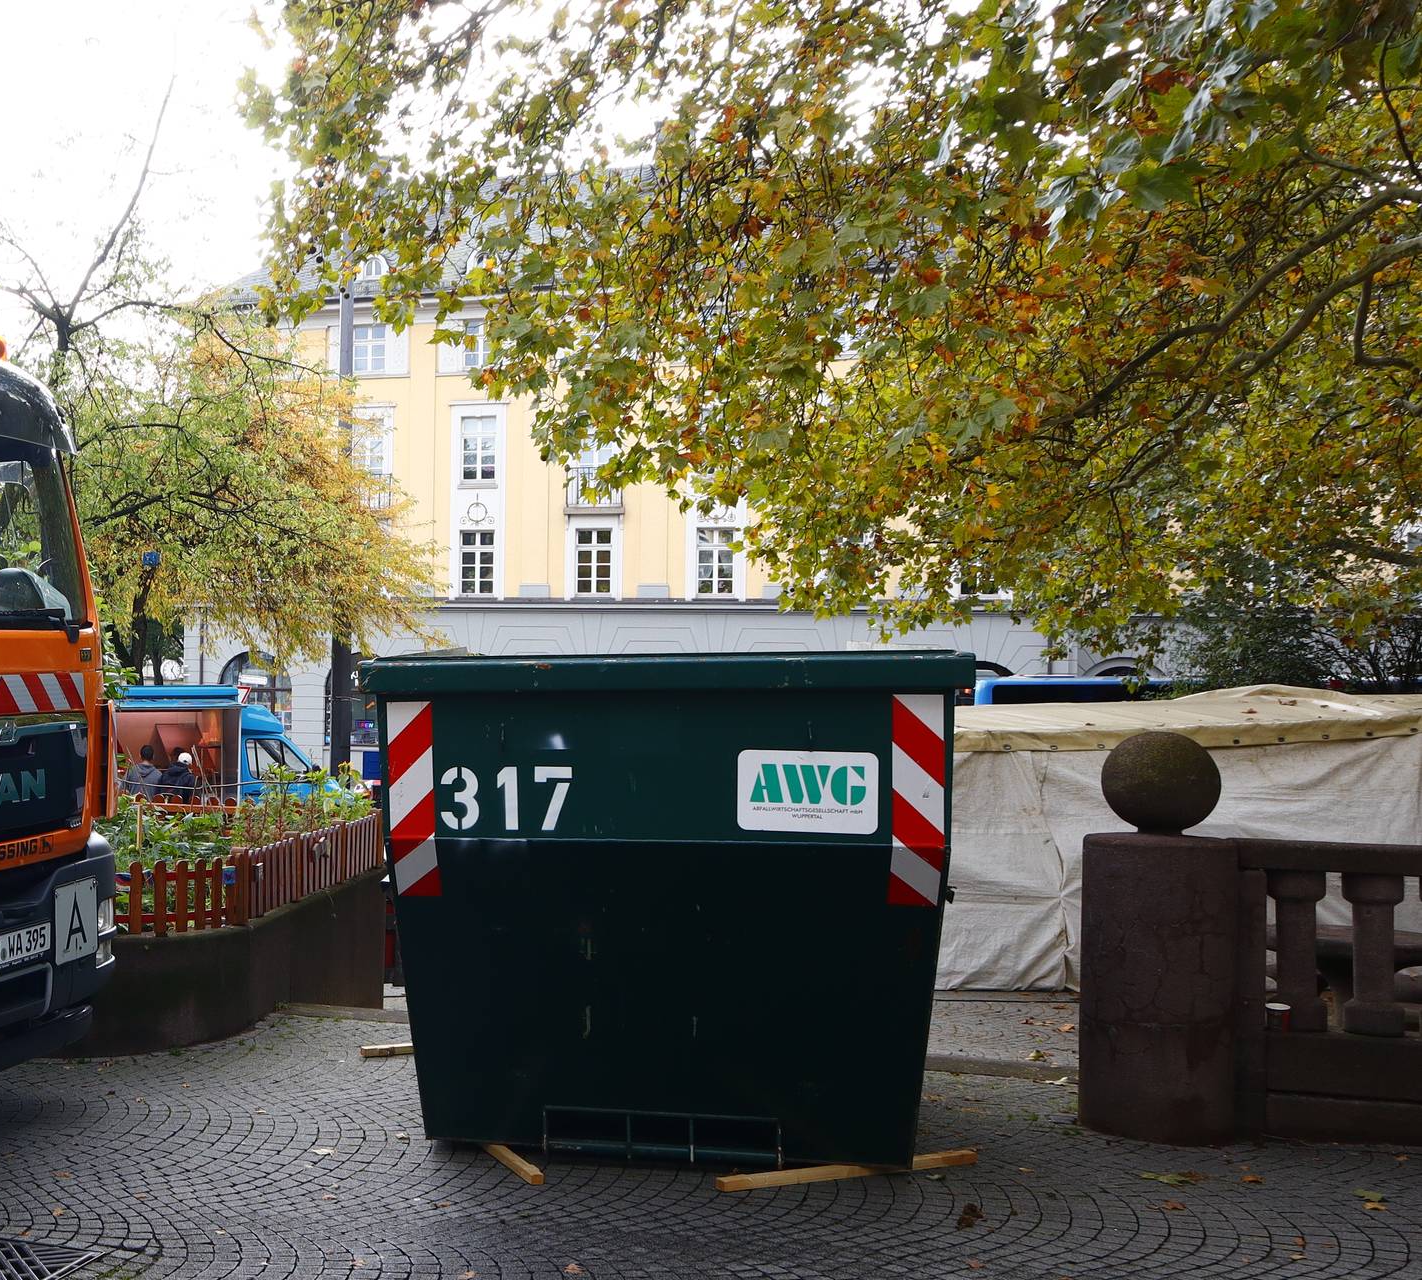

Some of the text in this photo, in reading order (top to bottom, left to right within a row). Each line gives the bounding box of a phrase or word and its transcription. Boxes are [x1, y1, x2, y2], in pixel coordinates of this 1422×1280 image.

[440, 766, 573, 831] 317
[749, 763, 867, 806] AWG
[752, 806, 848, 815] ABFALLWIRTSCHAFTSGESELLSCHAFT
[8, 932, 23, 957] WA
[25, 926, 47, 952] 395
[65, 891, 88, 951] A
